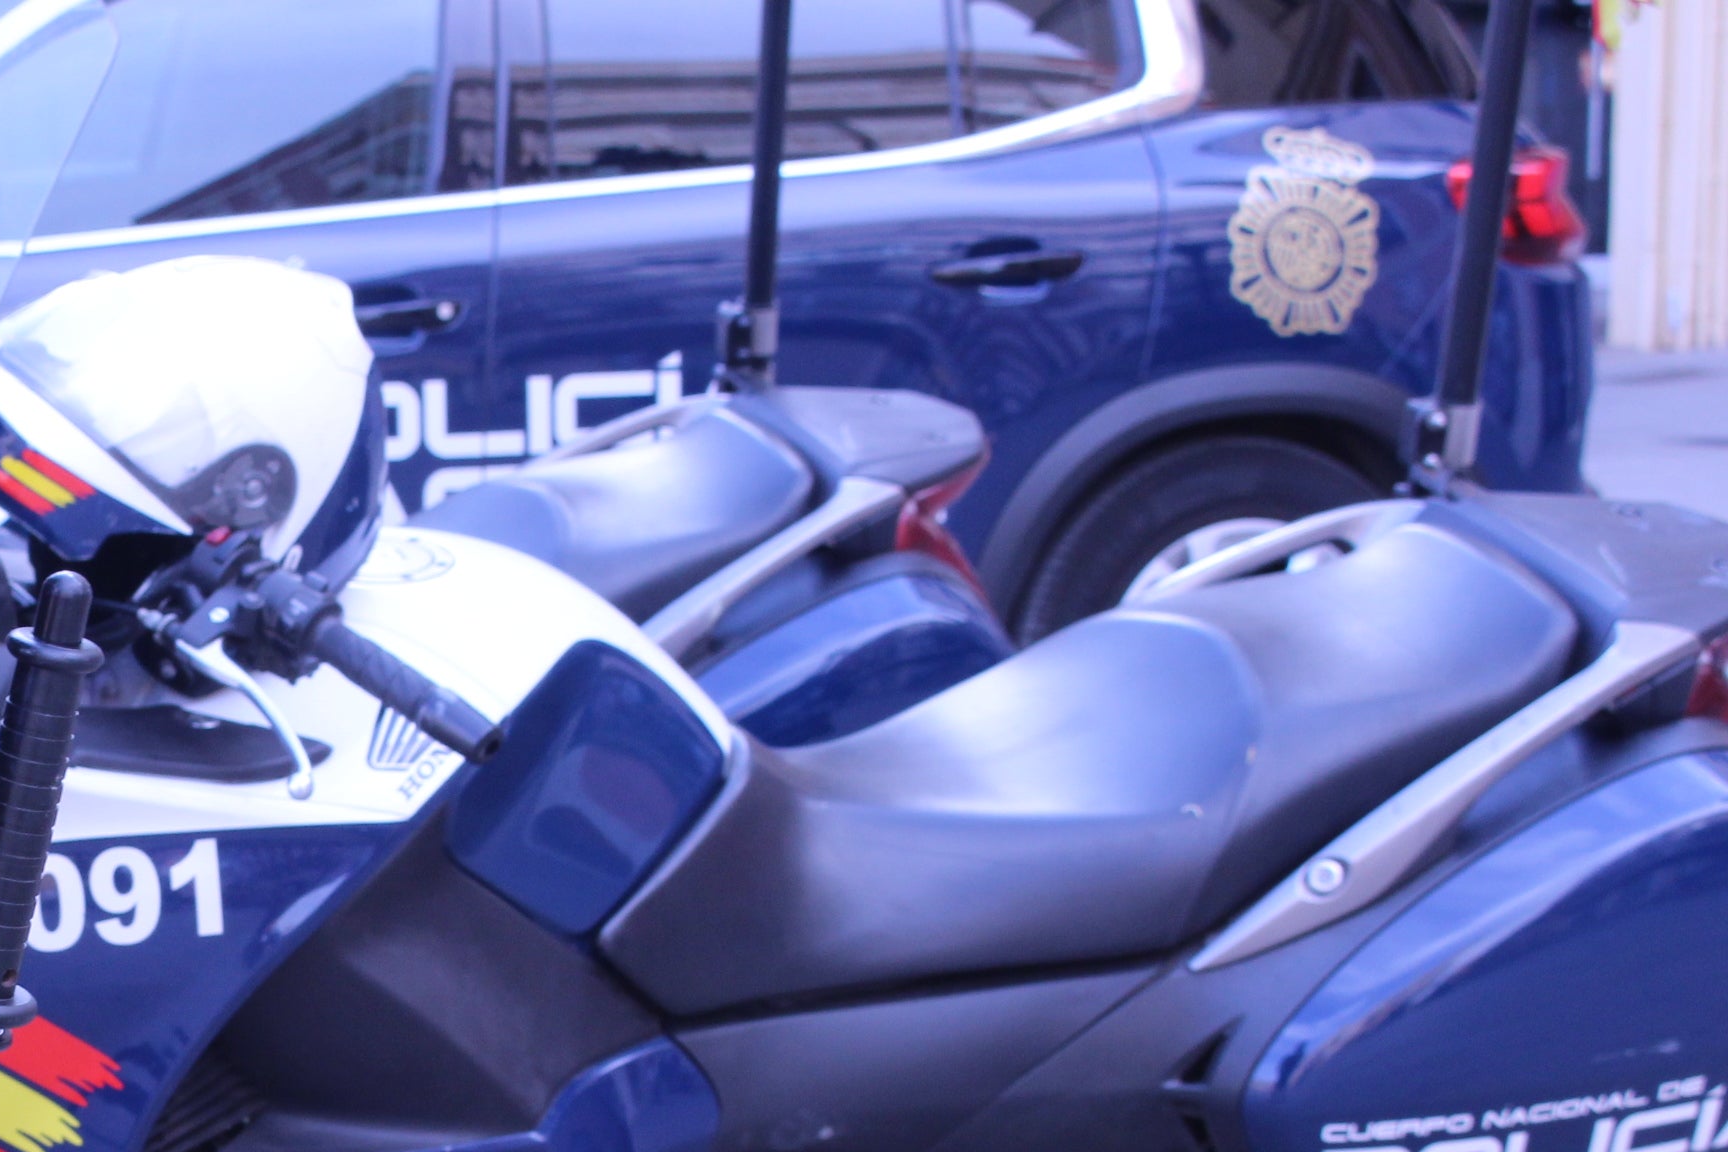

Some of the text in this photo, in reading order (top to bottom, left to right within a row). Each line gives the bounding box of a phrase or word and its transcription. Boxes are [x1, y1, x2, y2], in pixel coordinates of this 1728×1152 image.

[381, 350, 685, 462] LICÍ
[1321, 1073, 1708, 1144] CUERPO NACIONAL DE
